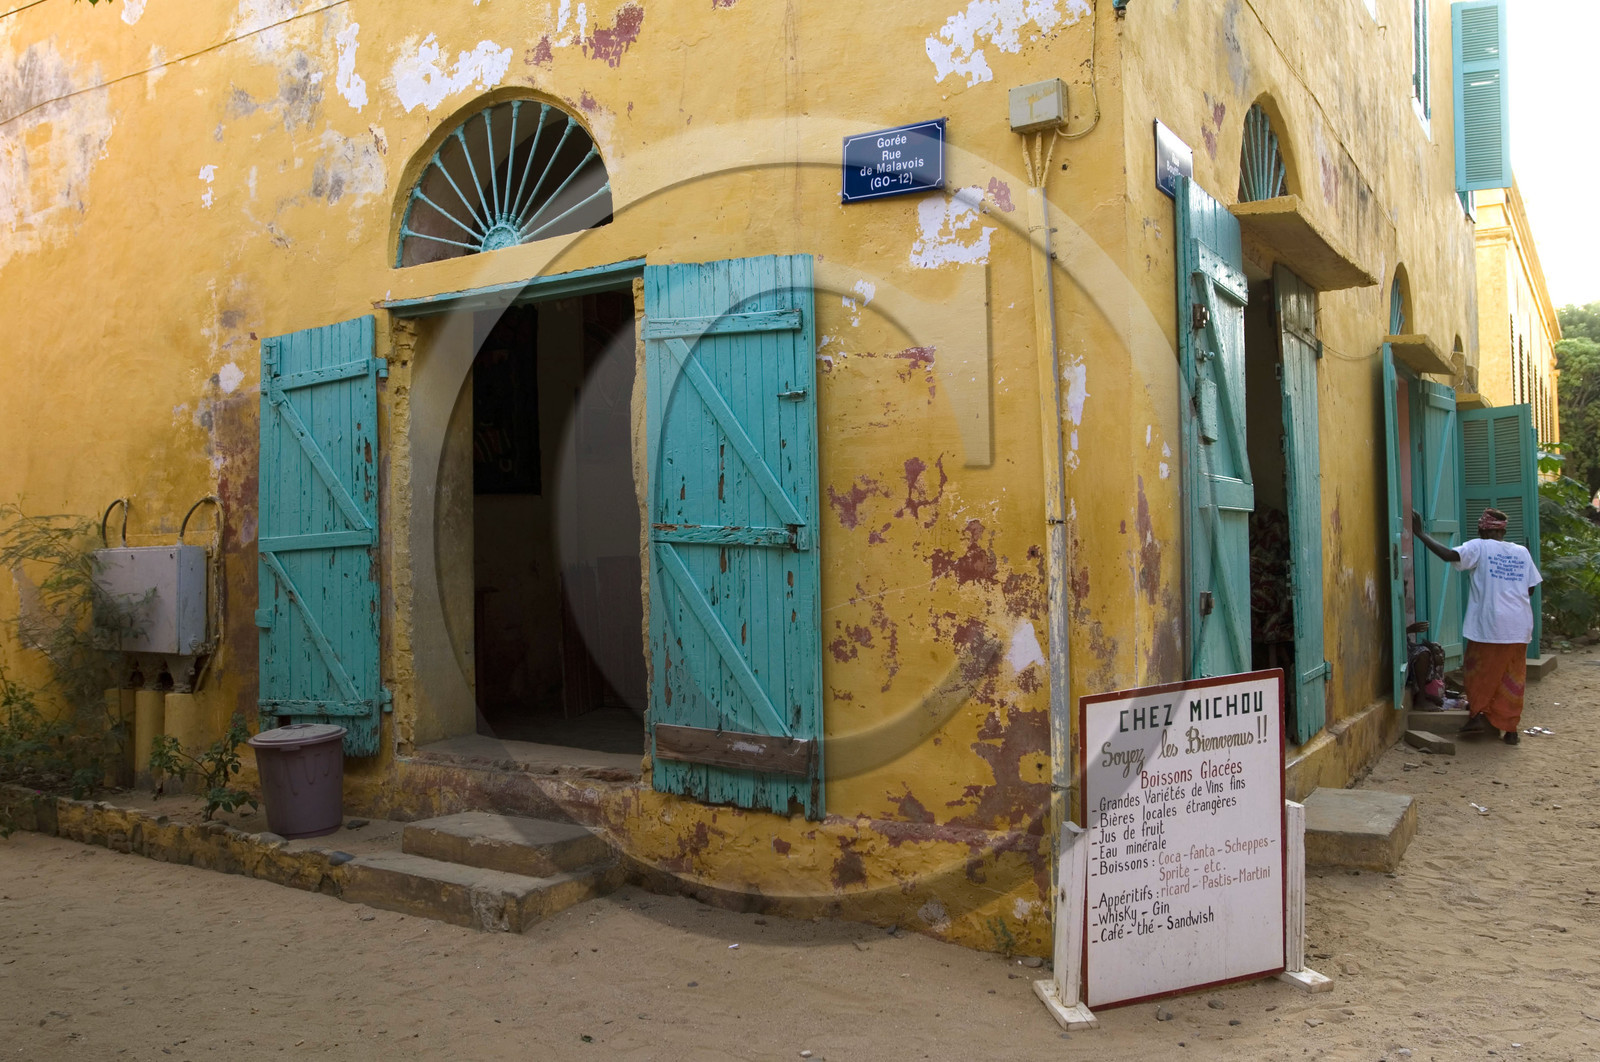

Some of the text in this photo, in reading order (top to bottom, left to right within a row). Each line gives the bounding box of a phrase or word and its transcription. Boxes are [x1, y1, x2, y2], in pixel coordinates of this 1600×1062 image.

[877, 135, 907, 148] Gorée
[860, 157, 924, 176] de Malavois
[882, 150, 901, 161] Rue
[1120, 691, 1263, 733] CHEZ MICHOU
[1101, 741, 1146, 779] Soyez
[1157, 729, 1178, 760] les
[1185, 726, 1254, 755] Bienvenus
[1141, 759, 1242, 789] Boissons Glacées
[1099, 793, 1140, 812] Grandes
[1144, 786, 1185, 805] Variétés
[1192, 783, 1202, 797] de
[1206, 780, 1223, 793] Vins
[1230, 775, 1246, 790] fins
[1100, 813, 1135, 828] Bières
[1143, 805, 1177, 821] locales
[1186, 796, 1237, 815] étrangères
[1123, 825, 1135, 840] de
[1142, 820, 1165, 837] fruit
[1100, 846, 1117, 859] Eau
[1126, 834, 1167, 855] minérale
[1100, 858, 1148, 875] Boissons
[1159, 864, 1190, 885] Sprite
[1204, 859, 1226, 874] etc.
[1099, 885, 1153, 912] Appéritifs
[1161, 879, 1190, 898] ricard
[1152, 901, 1170, 916] Gin
[1101, 924, 1124, 942] Café
[1137, 918, 1154, 935] thé
[1167, 905, 1214, 930] Sandwish
